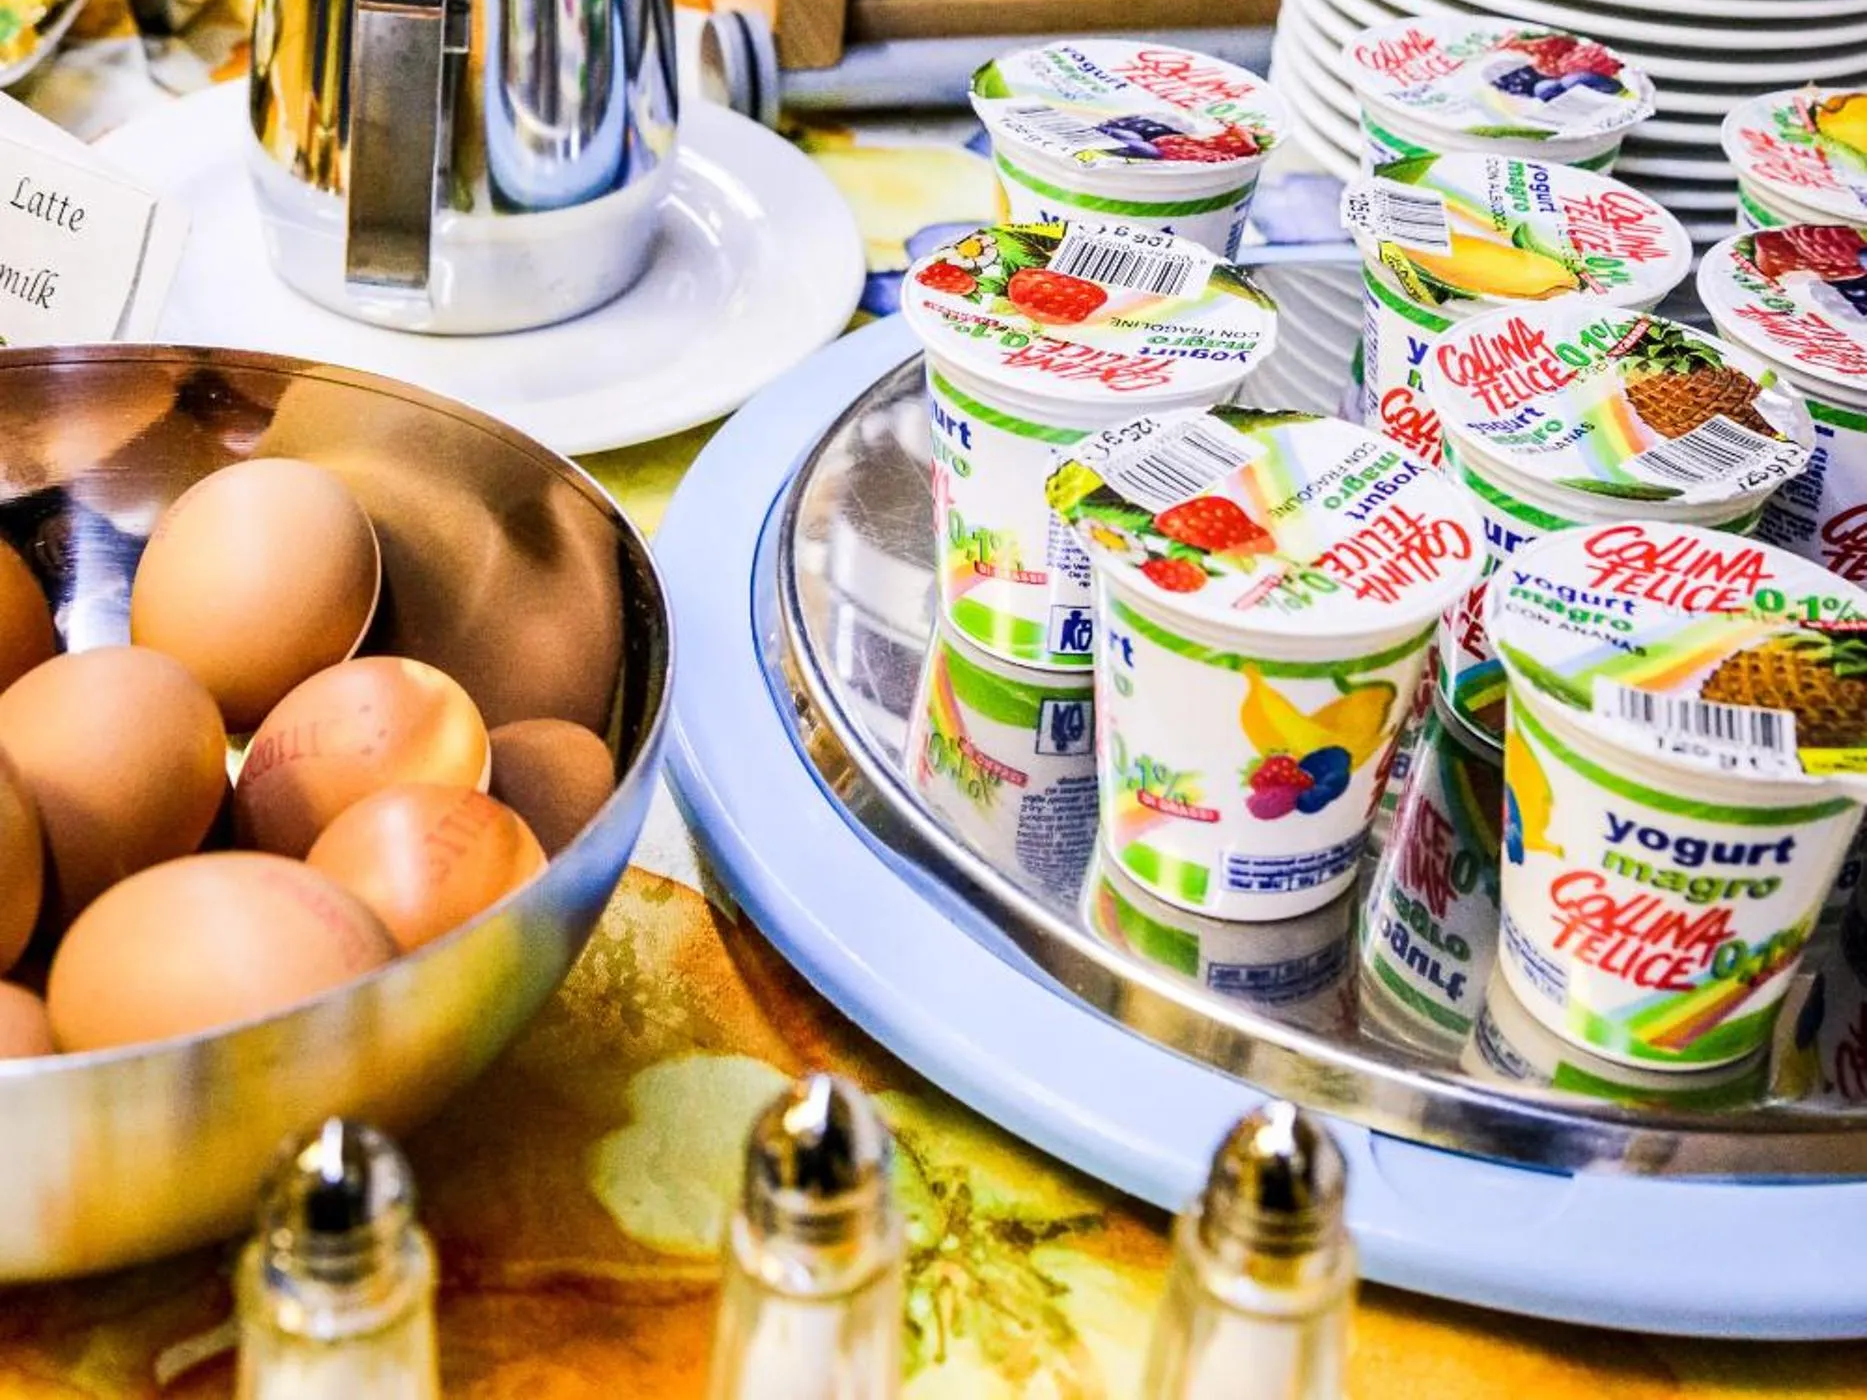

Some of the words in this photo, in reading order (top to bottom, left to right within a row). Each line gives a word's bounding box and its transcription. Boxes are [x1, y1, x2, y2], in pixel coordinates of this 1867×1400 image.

[10, 176, 86, 232] Latte
[1526, 163, 1558, 214] yogurt
[0, 262, 59, 309] milk
[1110, 316, 1216, 337] FRAGOLINE
[1144, 334, 1258, 352] magro
[1436, 316, 1559, 388] COLLINA
[999, 344, 1173, 392] COLLINA
[1136, 347, 1252, 366] yogurt
[1472, 359, 1578, 416] FELICE
[1466, 405, 1546, 435] yogurt
[1322, 451, 1400, 511] magro
[1343, 442, 1379, 466] CON
[1268, 459, 1349, 519] FRAGOLINE
[1344, 460, 1429, 521] yogurt
[1311, 504, 1426, 579] FELICE
[1354, 518, 1473, 605] COLLINA
[1584, 525, 1775, 596] COLLINA
[1508, 585, 1634, 633] magro
[1511, 570, 1638, 617] yogurt
[1585, 562, 1749, 614] FELICE
[1504, 603, 1553, 627] CON
[1556, 619, 1648, 658] ANANAS
[1604, 810, 1797, 867] yogurt
[1601, 850, 1784, 905] magro
[1550, 870, 1737, 968] COLLINA
[1551, 914, 1698, 992] FELICE
